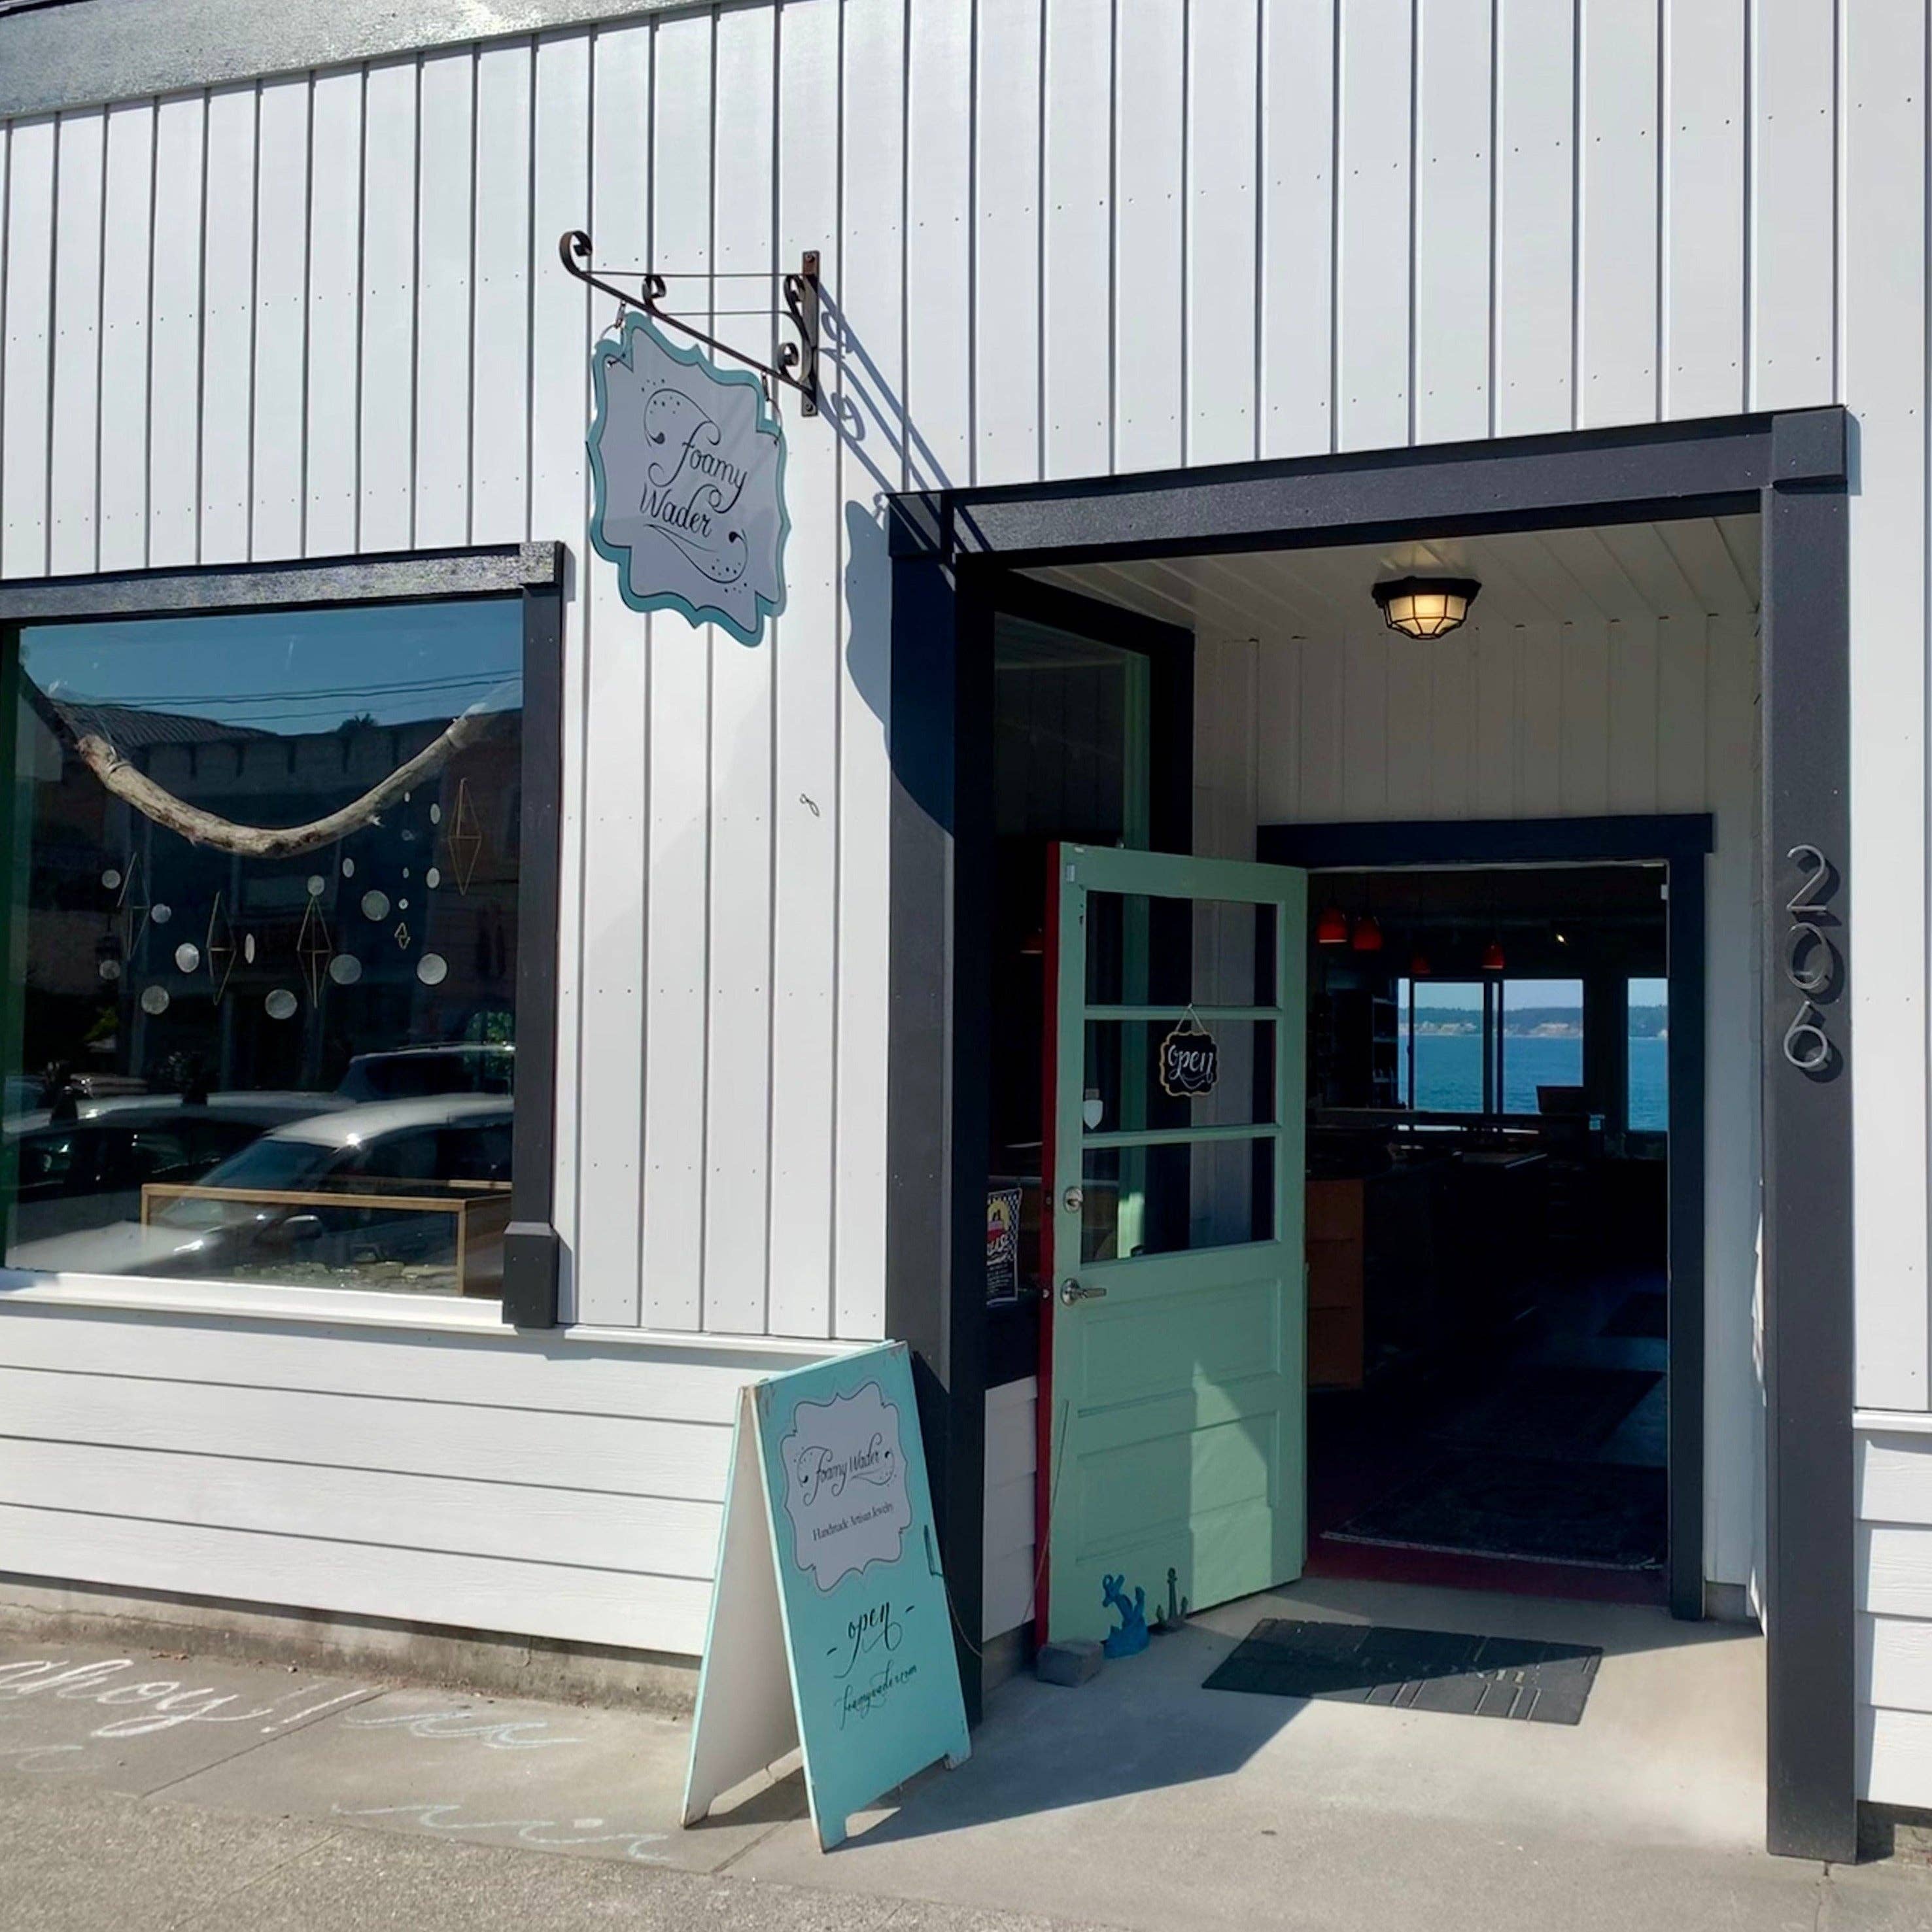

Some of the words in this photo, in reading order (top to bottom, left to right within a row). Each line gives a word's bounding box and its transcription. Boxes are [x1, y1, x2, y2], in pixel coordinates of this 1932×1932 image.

[638, 481, 722, 538] Wader
[1784, 844, 1829, 1068] 206
[850, 1432, 883, 1472] Wader
[833, 1602, 903, 1678] open
